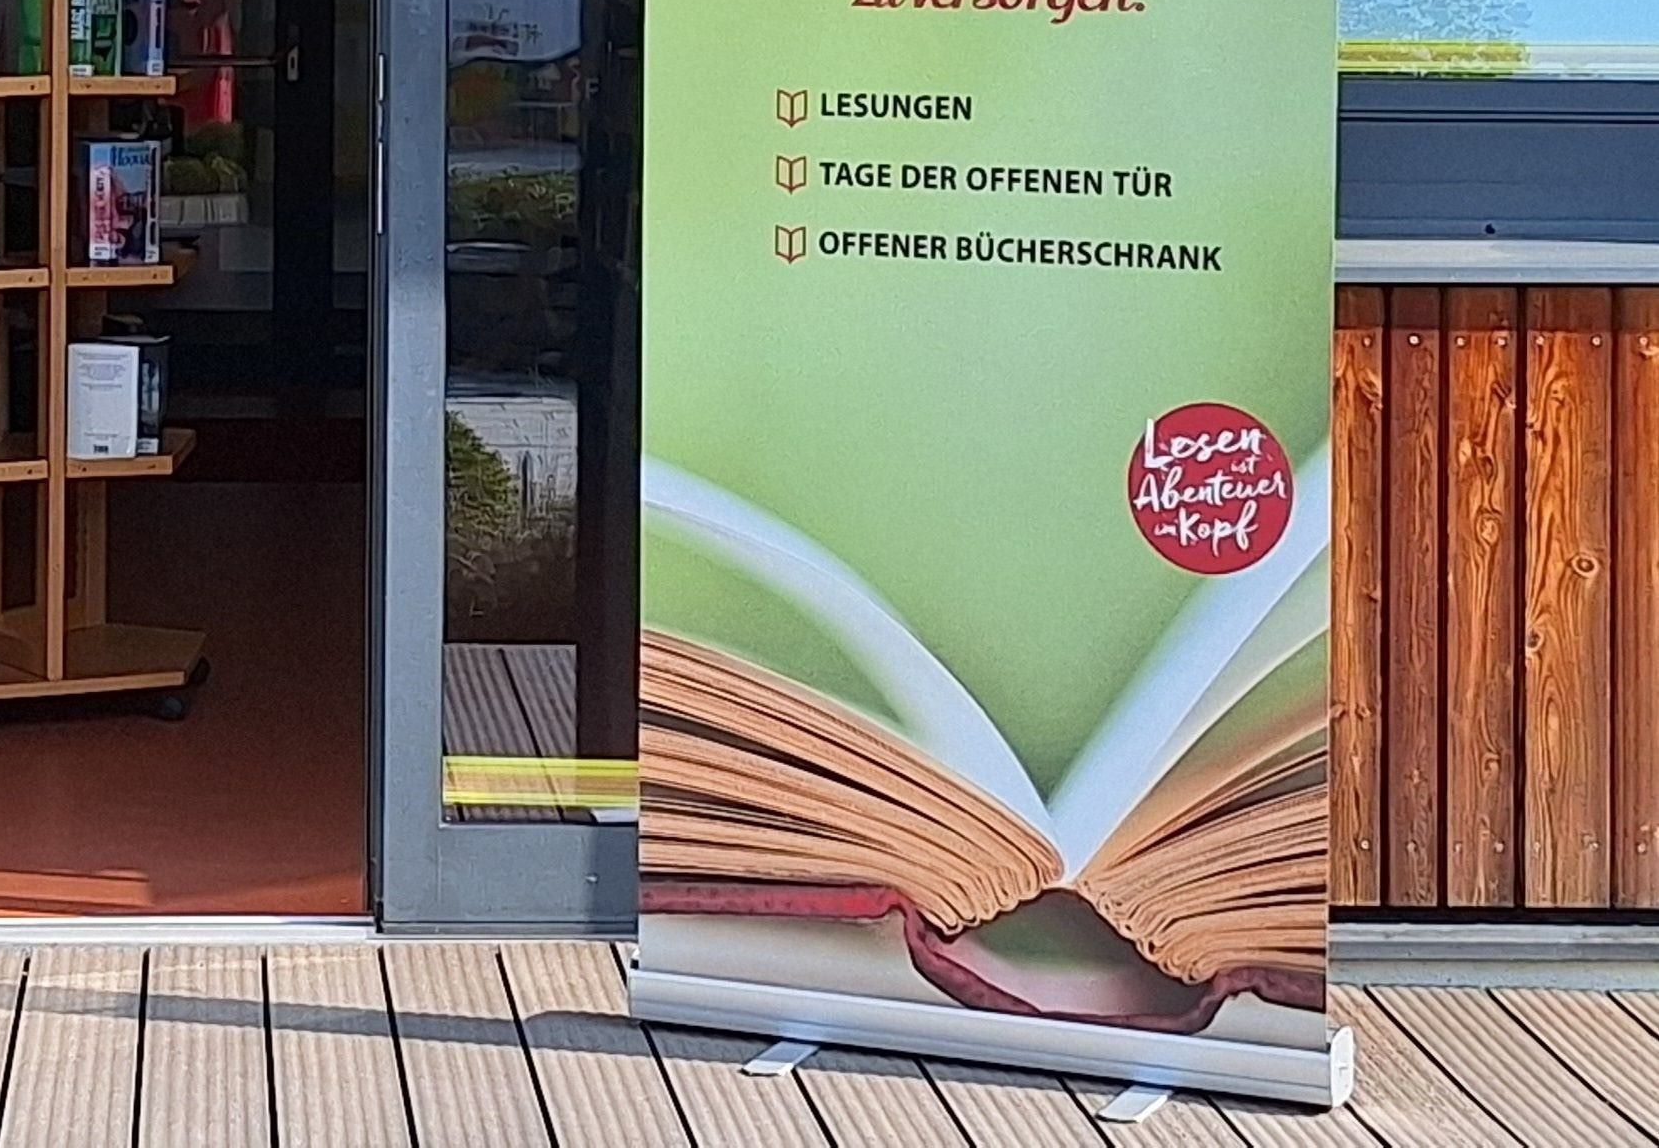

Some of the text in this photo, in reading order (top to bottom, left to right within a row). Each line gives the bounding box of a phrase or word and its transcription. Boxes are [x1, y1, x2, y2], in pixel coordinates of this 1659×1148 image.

[821, 93, 971, 120] LESUNGEN
[819, 162, 1172, 197] TAGE DER OFFENEN TÜR
[819, 231, 1221, 271] OFFENER BÜCHERSCHRANK
[1145, 418, 1267, 468] Lesen
[1231, 455, 1262, 474] ist
[1133, 466, 1287, 512] Abenteuer
[1178, 500, 1258, 557] Kopf
